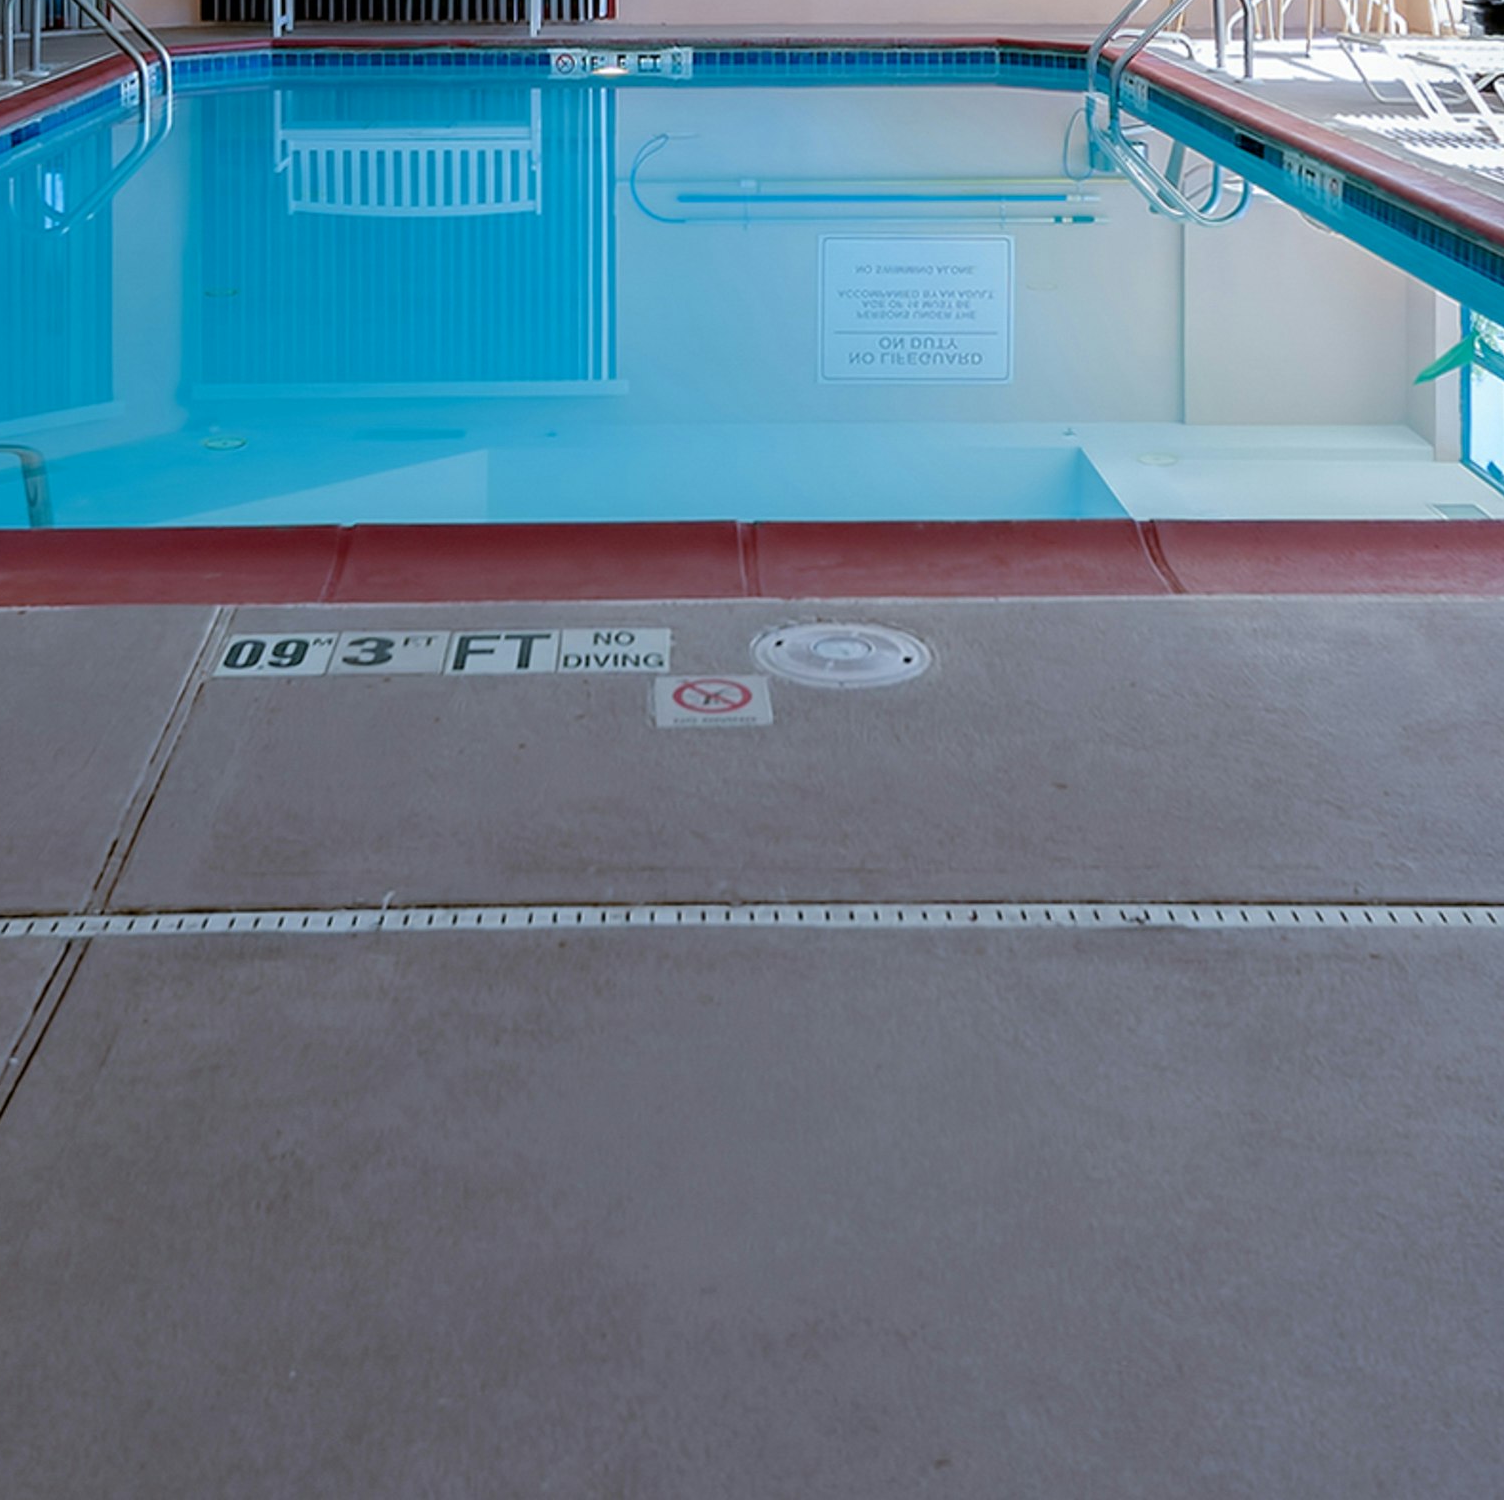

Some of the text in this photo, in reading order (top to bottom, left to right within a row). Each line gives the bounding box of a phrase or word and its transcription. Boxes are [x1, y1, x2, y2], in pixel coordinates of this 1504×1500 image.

[593, 631, 636, 646] NO
[342, 637, 395, 666] 3
[452, 634, 551, 671] FT
[562, 652, 664, 669] DIVING
